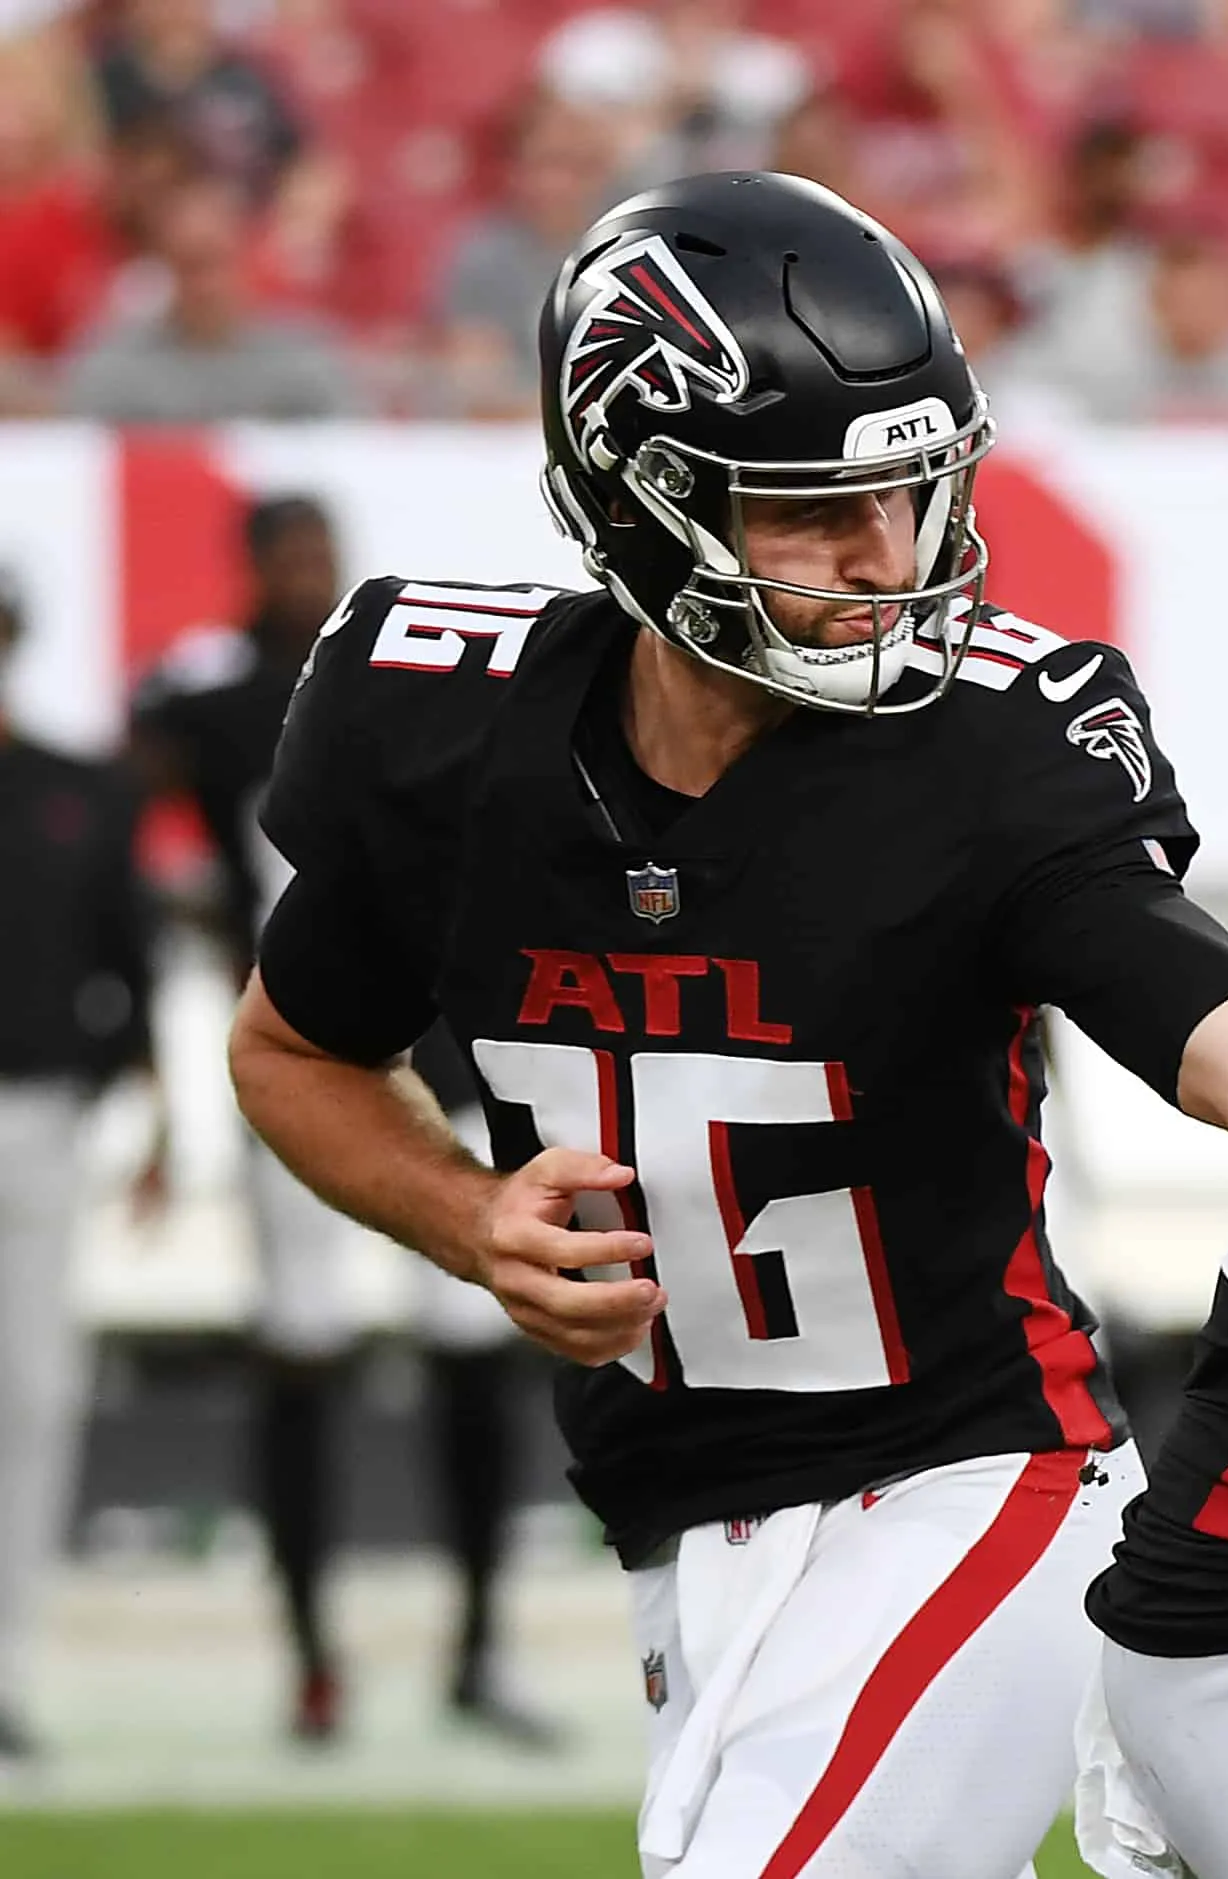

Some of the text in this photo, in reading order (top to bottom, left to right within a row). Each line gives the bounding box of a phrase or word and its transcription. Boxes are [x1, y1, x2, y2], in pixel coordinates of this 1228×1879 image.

[885, 415, 938, 446] ATL
[368, 582, 561, 681] 16
[516, 948, 793, 1044] ATL
[472, 1038, 911, 1393] 16
